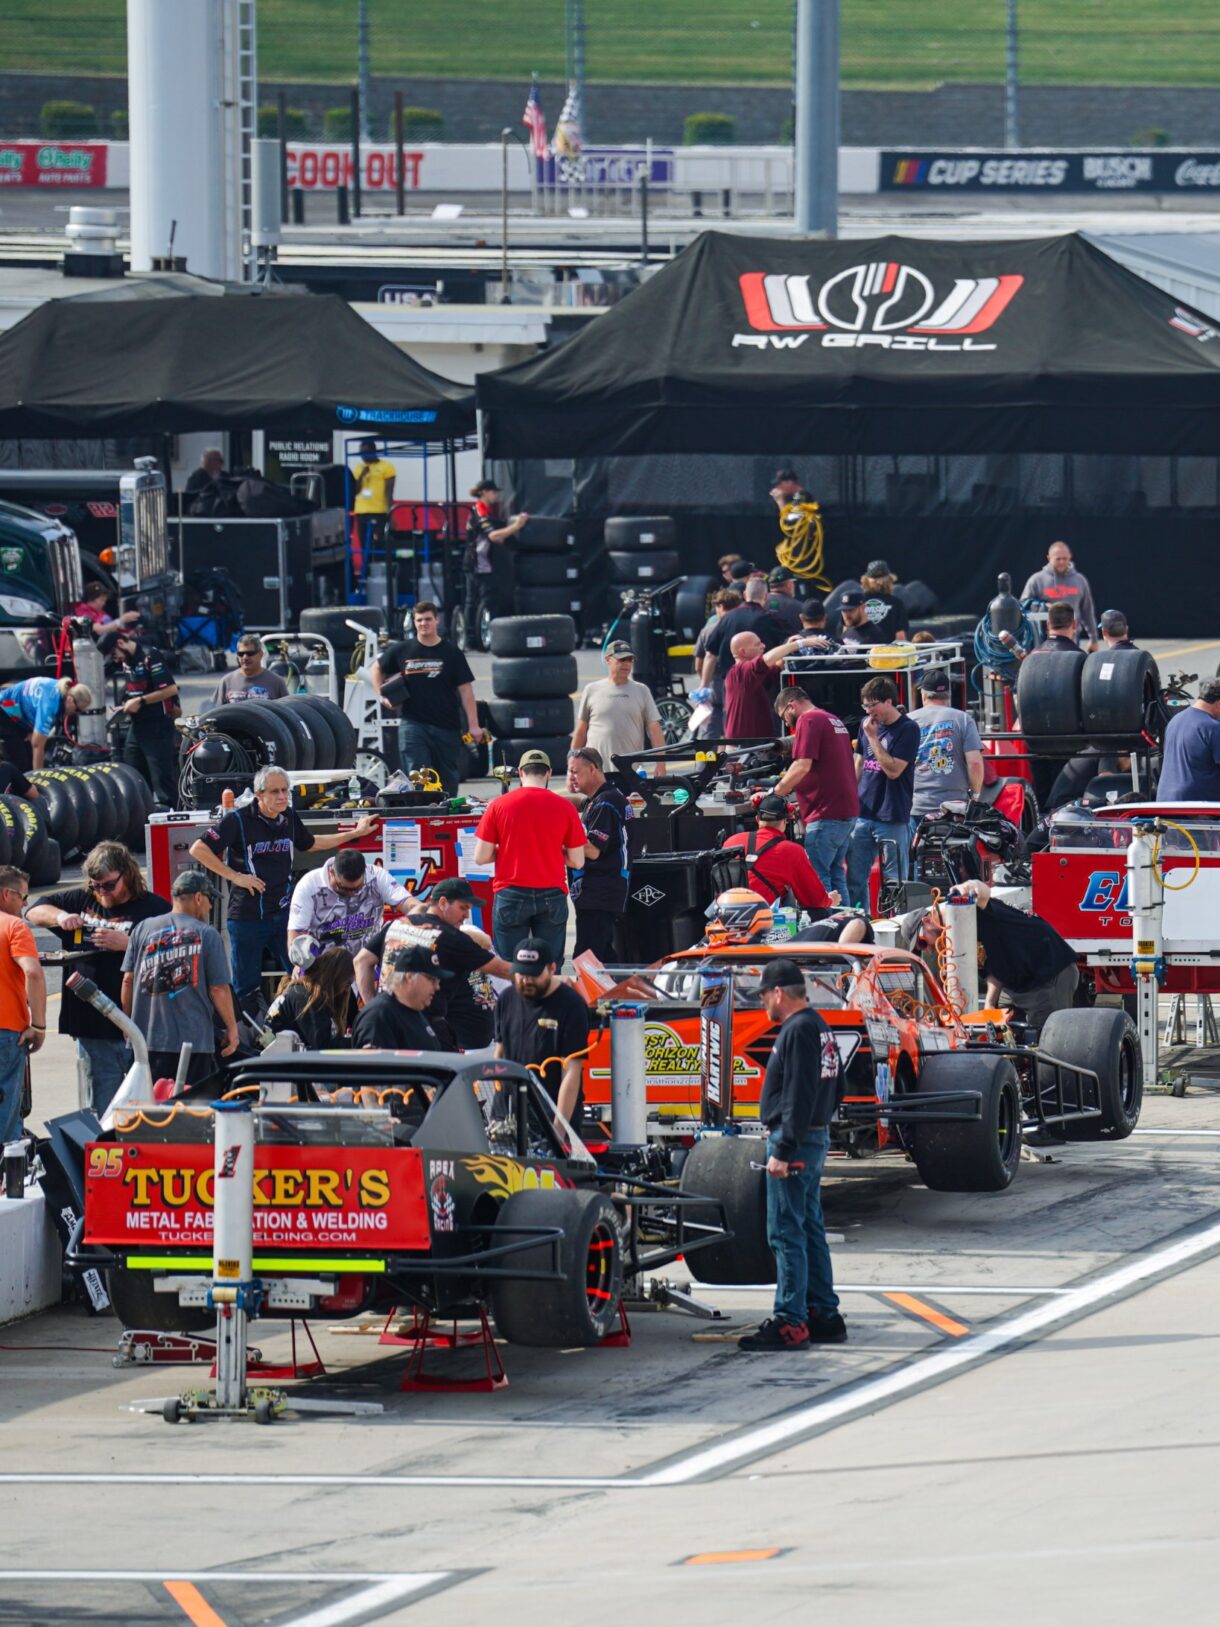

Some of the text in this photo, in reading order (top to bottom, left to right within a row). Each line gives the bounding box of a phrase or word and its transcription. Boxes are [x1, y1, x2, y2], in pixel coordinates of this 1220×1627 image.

[366, 152, 424, 188] OUT
[927, 160, 1068, 185] CUP SERIES
[1083, 157, 1152, 182] BUSCH
[731, 333, 997, 351] RW GRILL
[645, 1034, 669, 1046] RST
[646, 1047, 698, 1058] ORIZON
[707, 1020, 721, 1103] HARTWIG
[651, 1060, 699, 1071] REALTY
[88, 1148, 124, 1177] 95
[126, 1211, 388, 1230] METAL FABTION & WELDING
